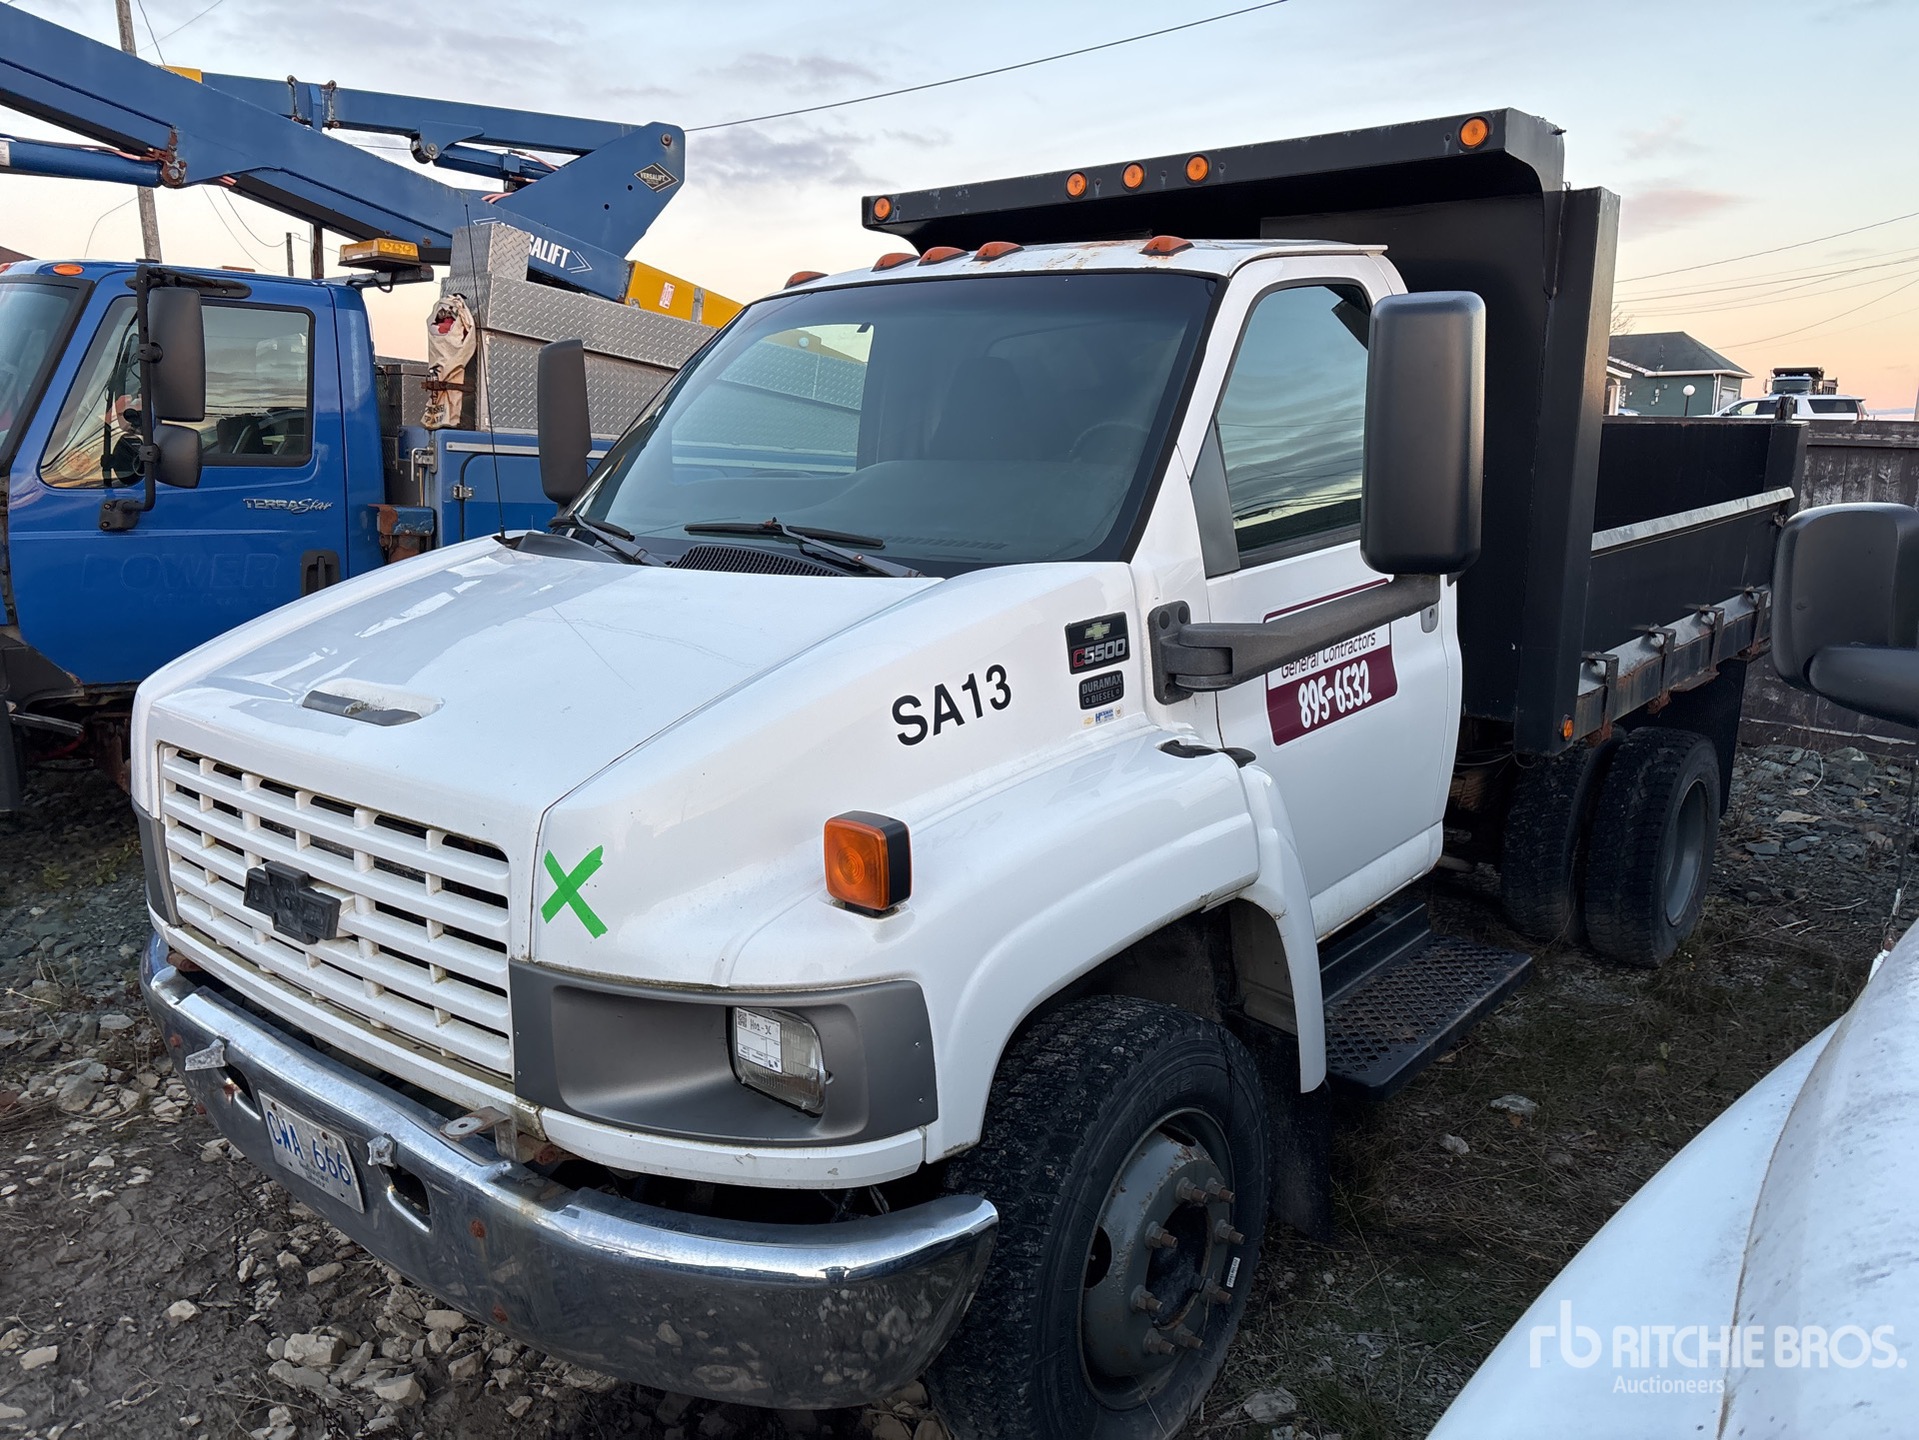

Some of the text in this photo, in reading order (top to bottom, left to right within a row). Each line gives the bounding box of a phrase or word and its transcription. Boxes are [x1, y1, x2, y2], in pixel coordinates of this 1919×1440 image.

[640, 172, 666, 181] VERSALIFT
[1072, 638, 1126, 668] C5500
[1281, 632, 1376, 679] General Contractors
[1082, 674, 1122, 694] DURAMAX
[1091, 690, 1115, 703] DIESEL
[1298, 659, 1372, 729] 895-6532
[892, 664, 1012, 746] SA13
[267, 1111, 305, 1160] CWA
[312, 1137, 352, 1186] 666
